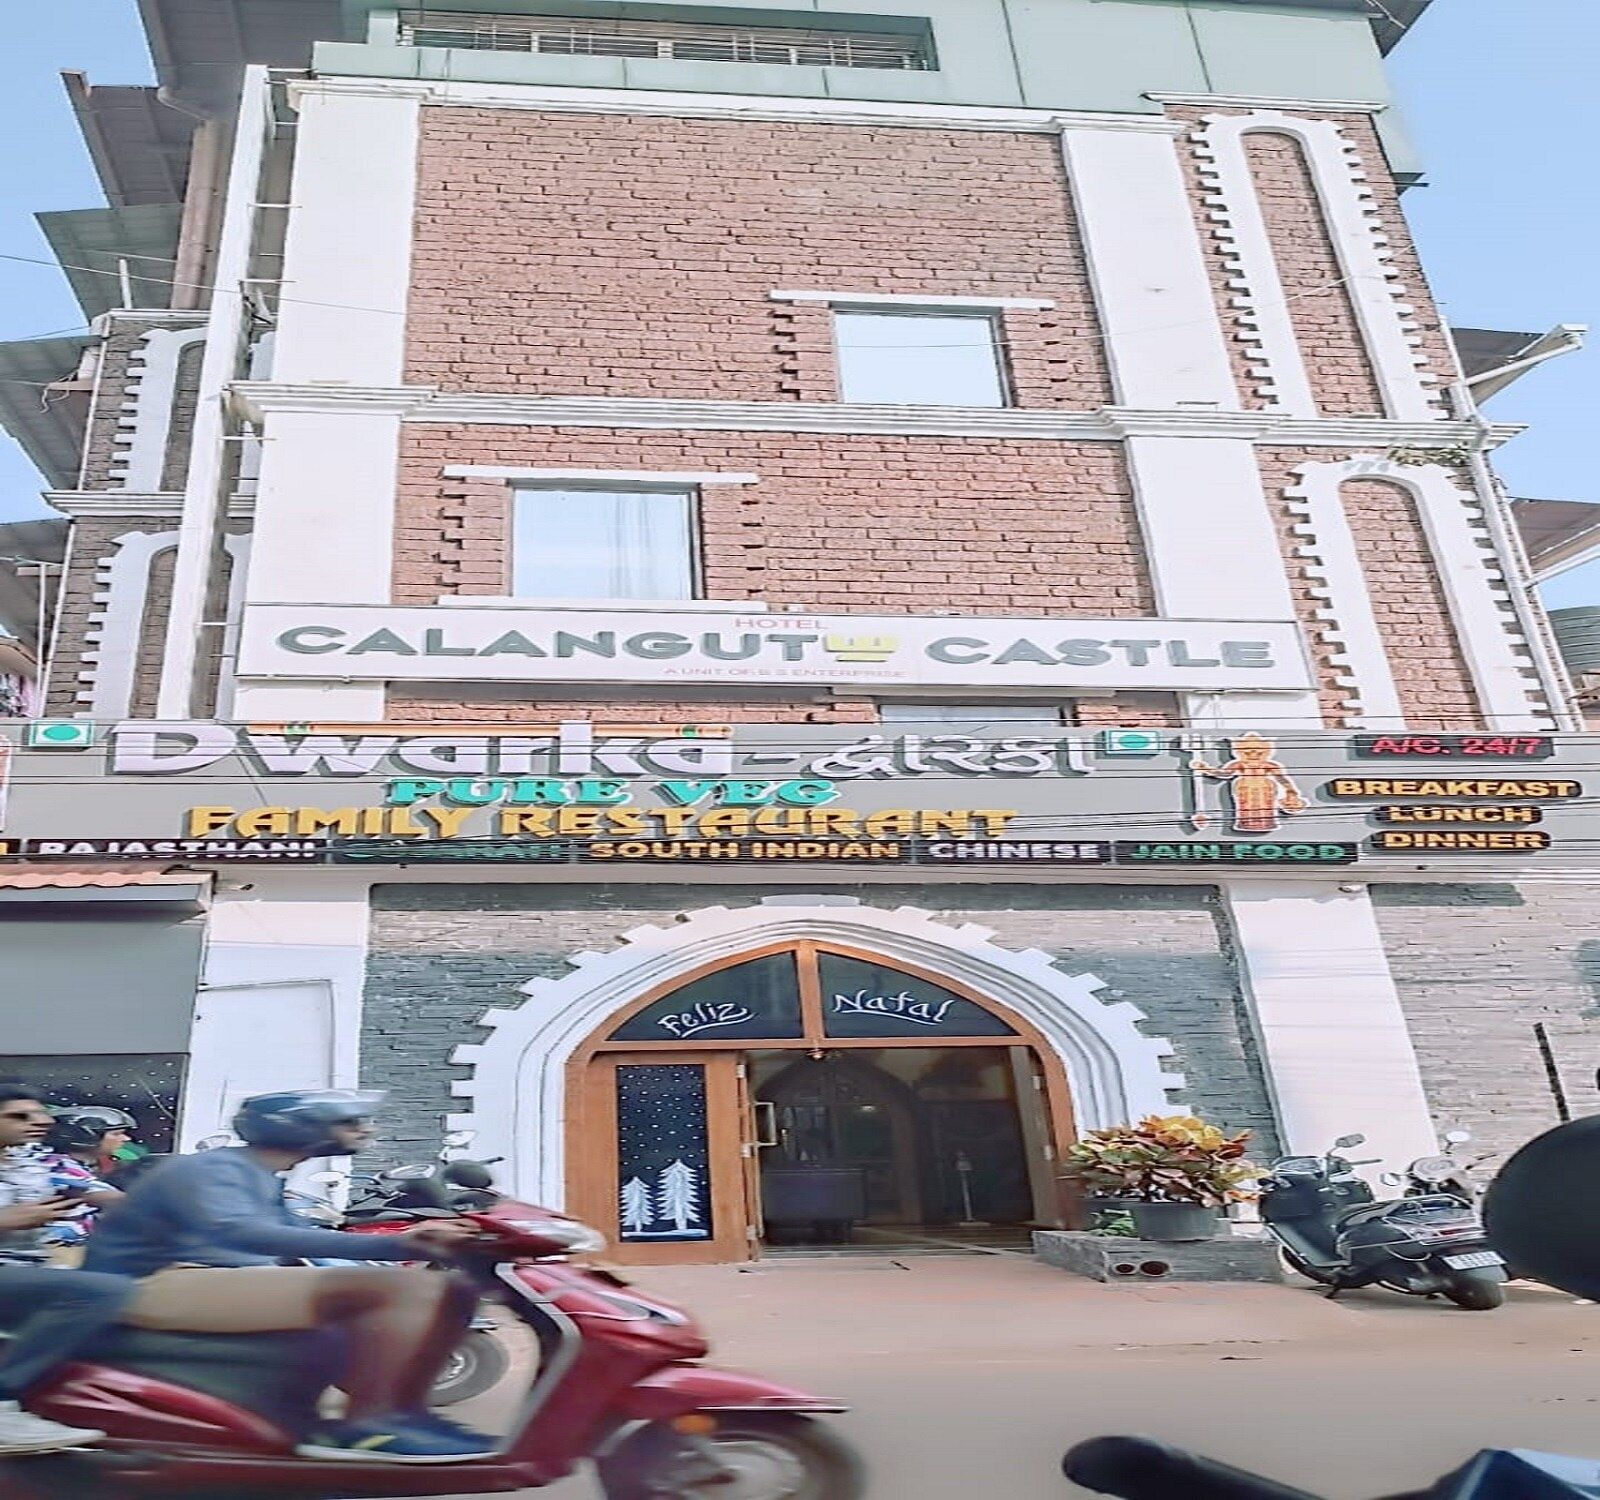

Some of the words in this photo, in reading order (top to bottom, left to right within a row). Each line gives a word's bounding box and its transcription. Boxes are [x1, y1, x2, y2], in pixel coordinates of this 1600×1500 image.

[735, 617, 828, 630] HOTEL
[926, 637, 1275, 668] CASTLE
[108, 721, 734, 776] Dwarka
[1462, 737, 1541, 756] 24/7
[389, 778, 630, 806] PURE
[652, 779, 840, 807] VEG
[1335, 778, 1577, 798] BREAKFAST
[188, 806, 472, 839] FAMILY
[500, 807, 1018, 840] RESTAURANT
[1389, 805, 1532, 823] LUNCH
[1384, 831, 1546, 849] DINNER
[38, 842, 316, 858] RAJASTHANI
[591, 842, 740, 858] SOUTH
[751, 842, 900, 859] INDIAN
[929, 843, 1100, 859] CHINESE
[1129, 842, 1220, 860] JAIN
[1233, 842, 1346, 860] FOOD
[657, 1001, 755, 1038] Feliz
[832, 989, 954, 1026] Natal
